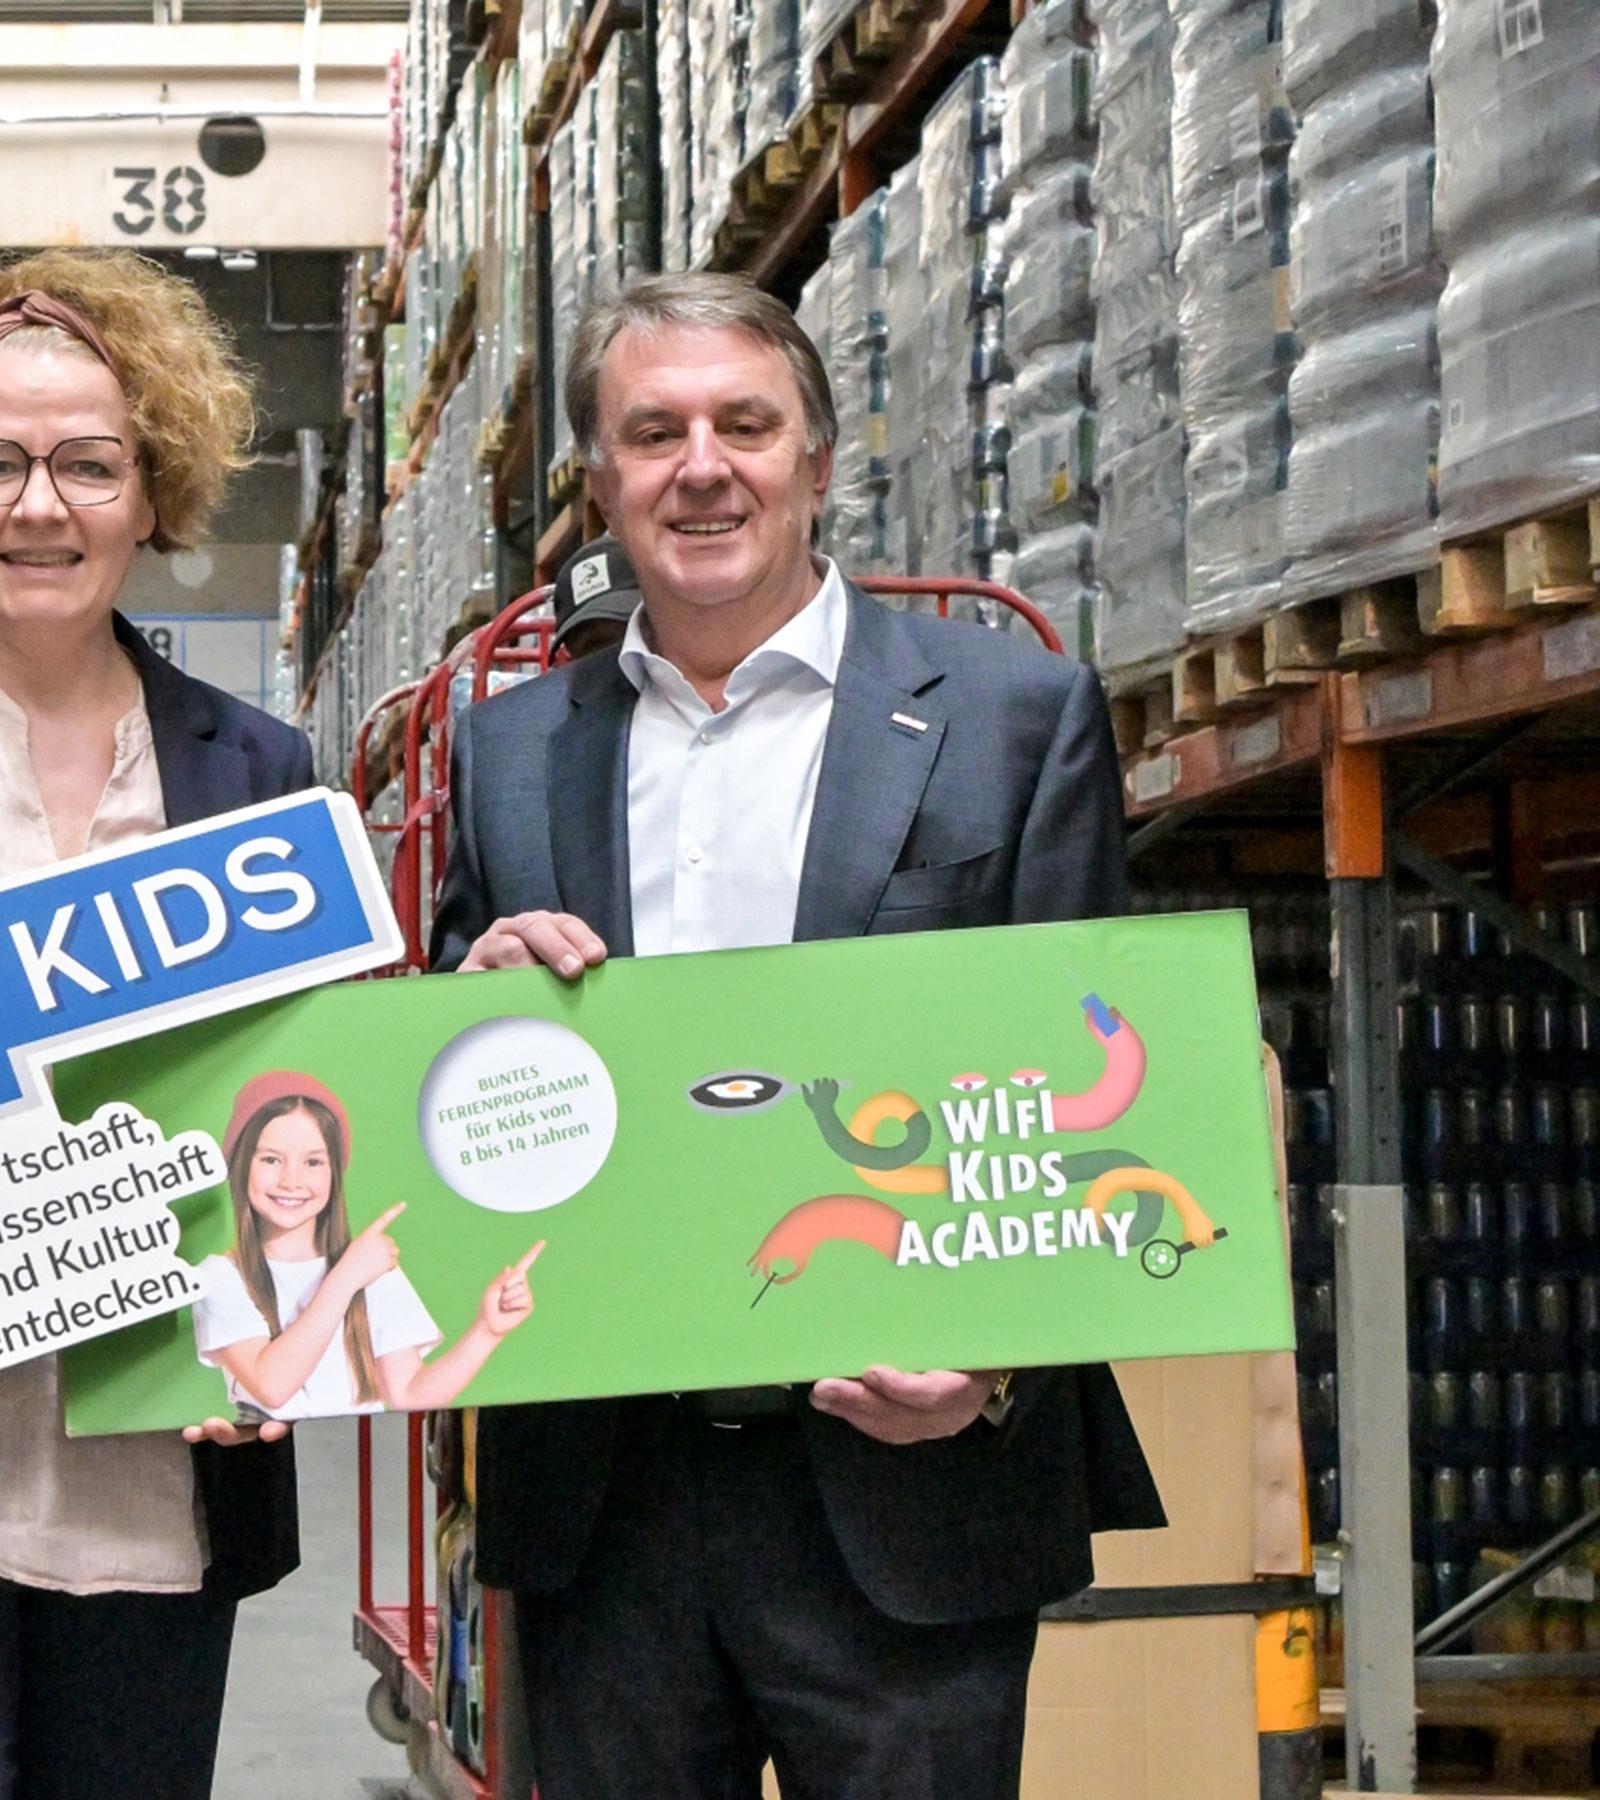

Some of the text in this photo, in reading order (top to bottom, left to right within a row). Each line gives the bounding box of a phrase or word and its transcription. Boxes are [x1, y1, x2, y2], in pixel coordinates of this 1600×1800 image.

[113, 166, 206, 235] 38
[8, 836, 316, 1011] KIDS
[438, 1073, 590, 1123] FERIENPROGRAMM
[478, 1064, 540, 1092] BUNTES
[465, 1103, 573, 1141] für Kids von
[939, 1087, 1056, 1145] WIFI
[459, 1122, 590, 1166] 8 bis 14 Jahren
[948, 1150, 1068, 1203] KIDS
[46, 1216, 171, 1280] Kultur
[896, 1207, 1136, 1268] ACADEMY
